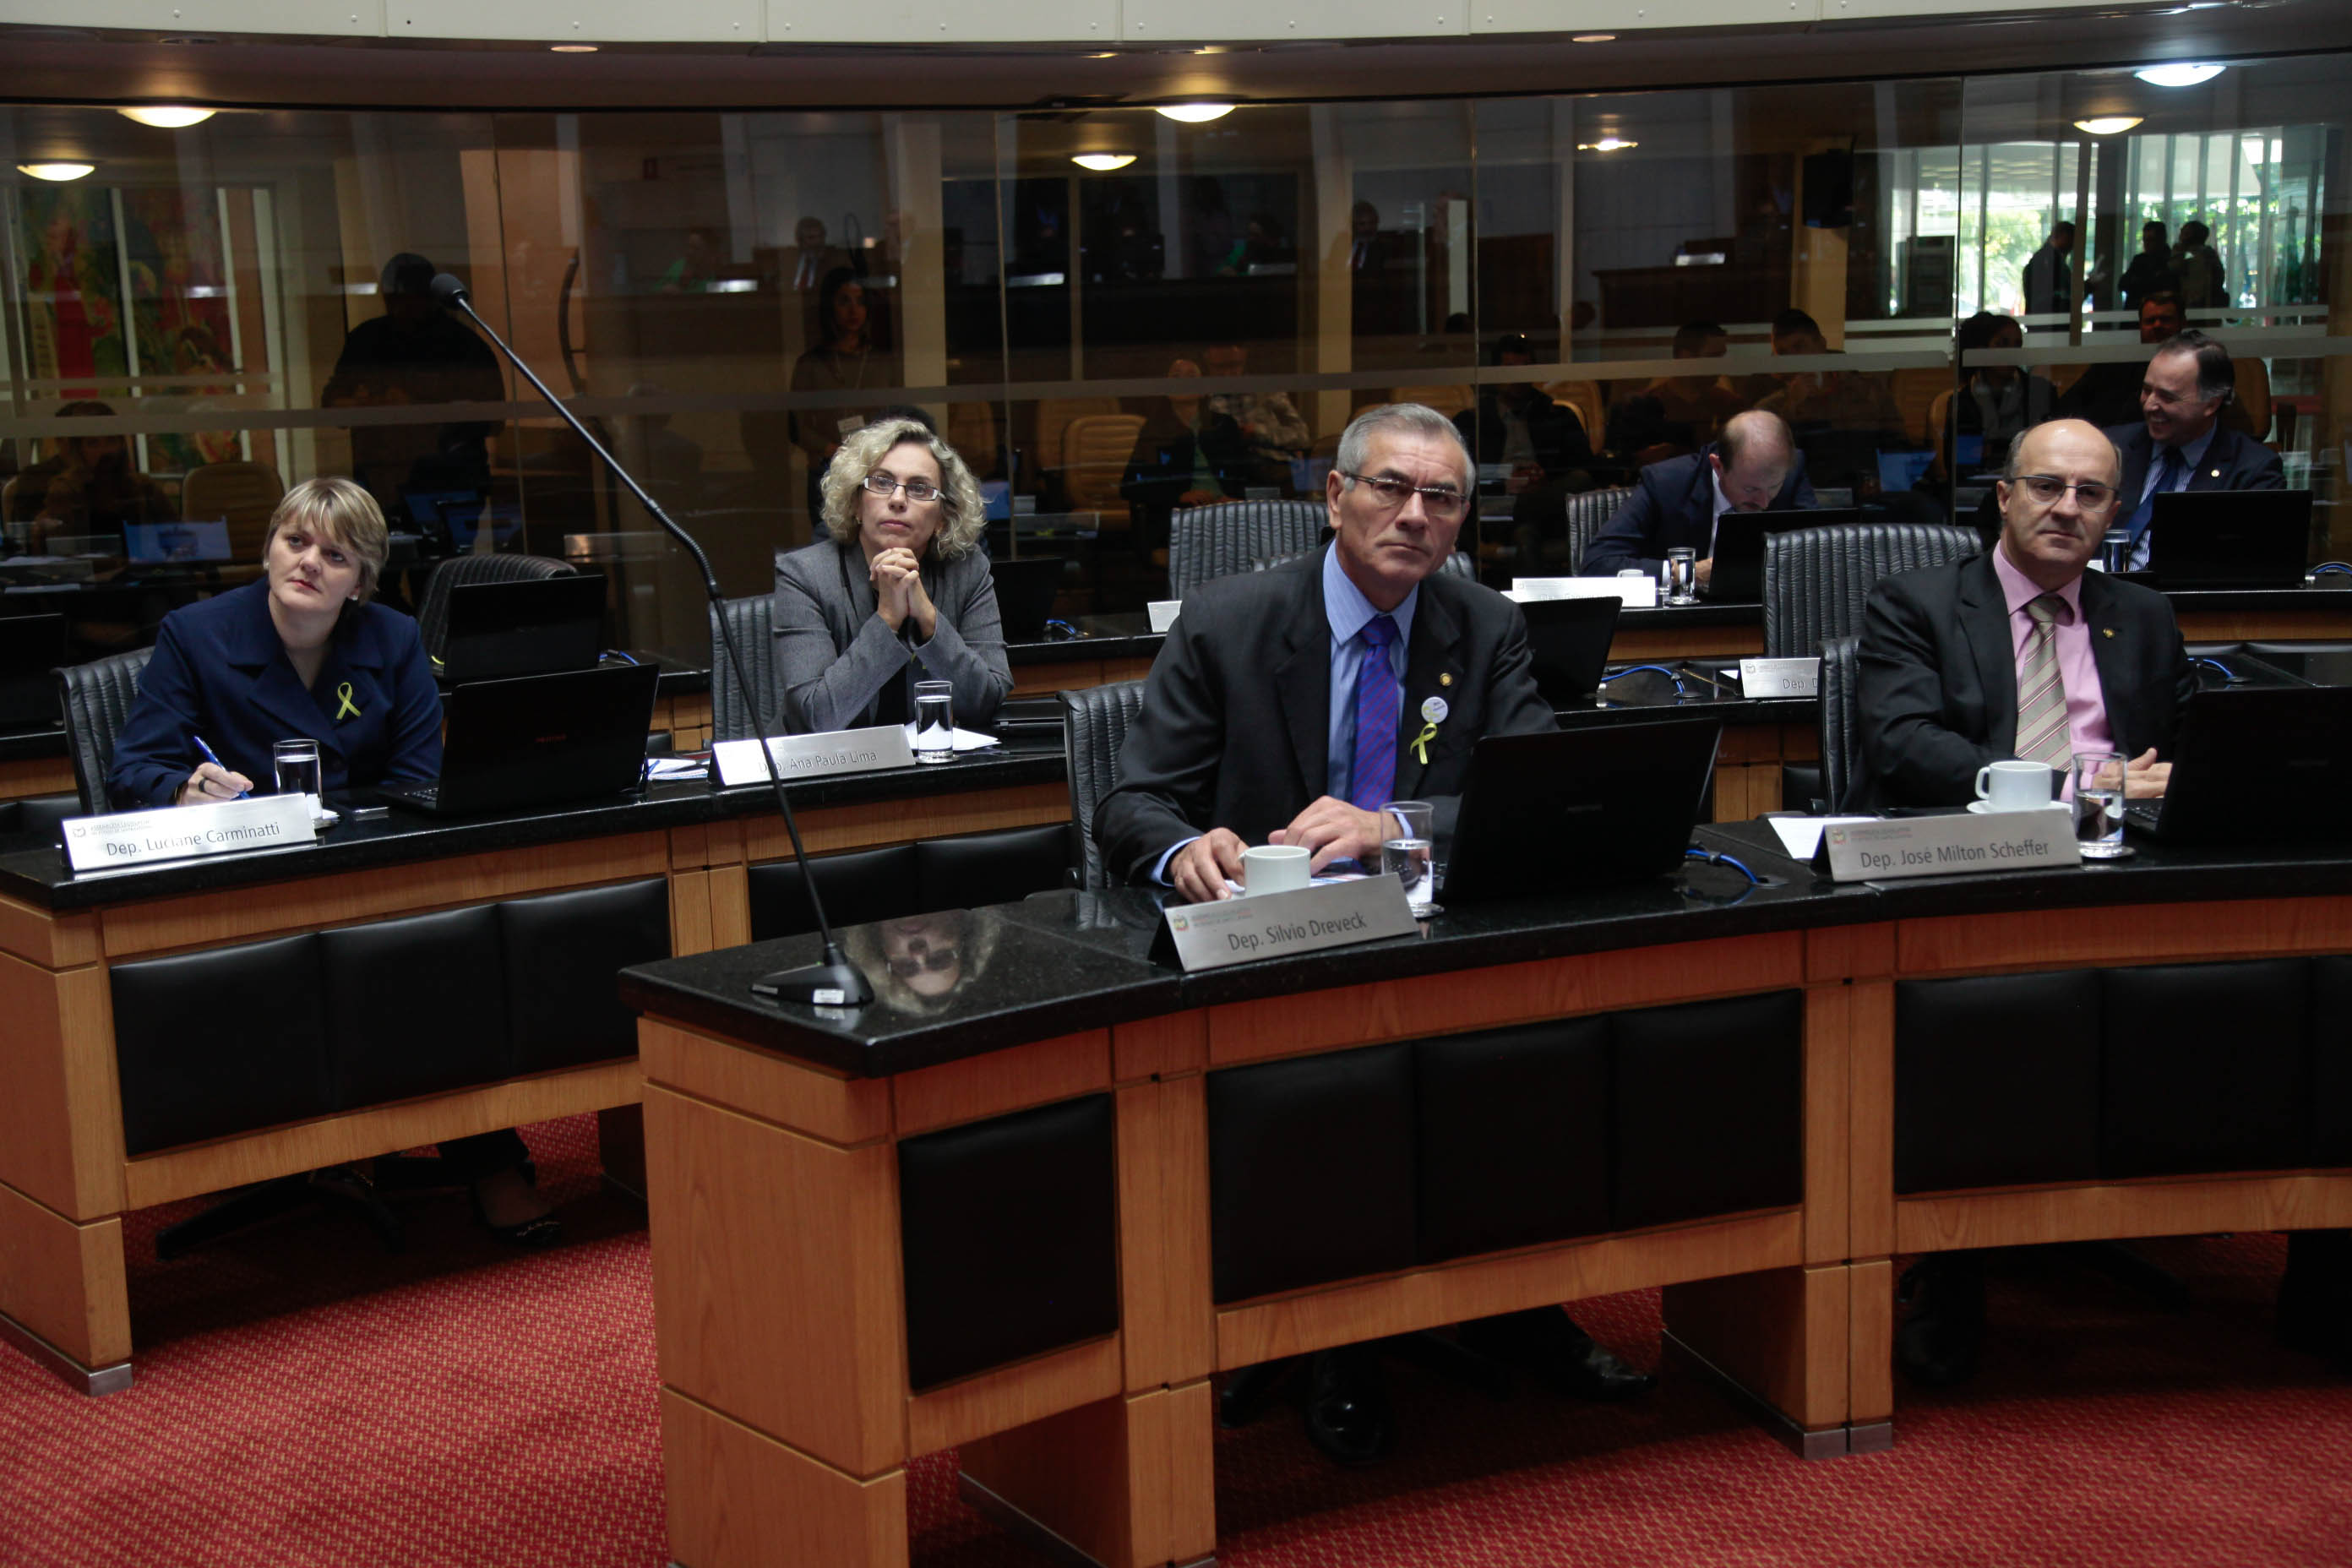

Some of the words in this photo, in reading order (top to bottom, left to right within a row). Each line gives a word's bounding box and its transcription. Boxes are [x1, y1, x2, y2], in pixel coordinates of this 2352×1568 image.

[790, 758, 812, 770] Ana
[815, 753, 847, 767] Paula
[850, 749, 878, 764] Lima
[106, 841, 142, 858] Dep.
[206, 821, 280, 843] Carminatti
[1860, 852, 1896, 869] Dep.
[1901, 847, 1933, 866] José
[1936, 844, 1986, 863] Milton
[1990, 840, 2050, 859] Scheffer
[1228, 933, 1265, 952] Dep.
[1266, 921, 1306, 945] Silvio
[1309, 912, 1368, 937] Dreveck
